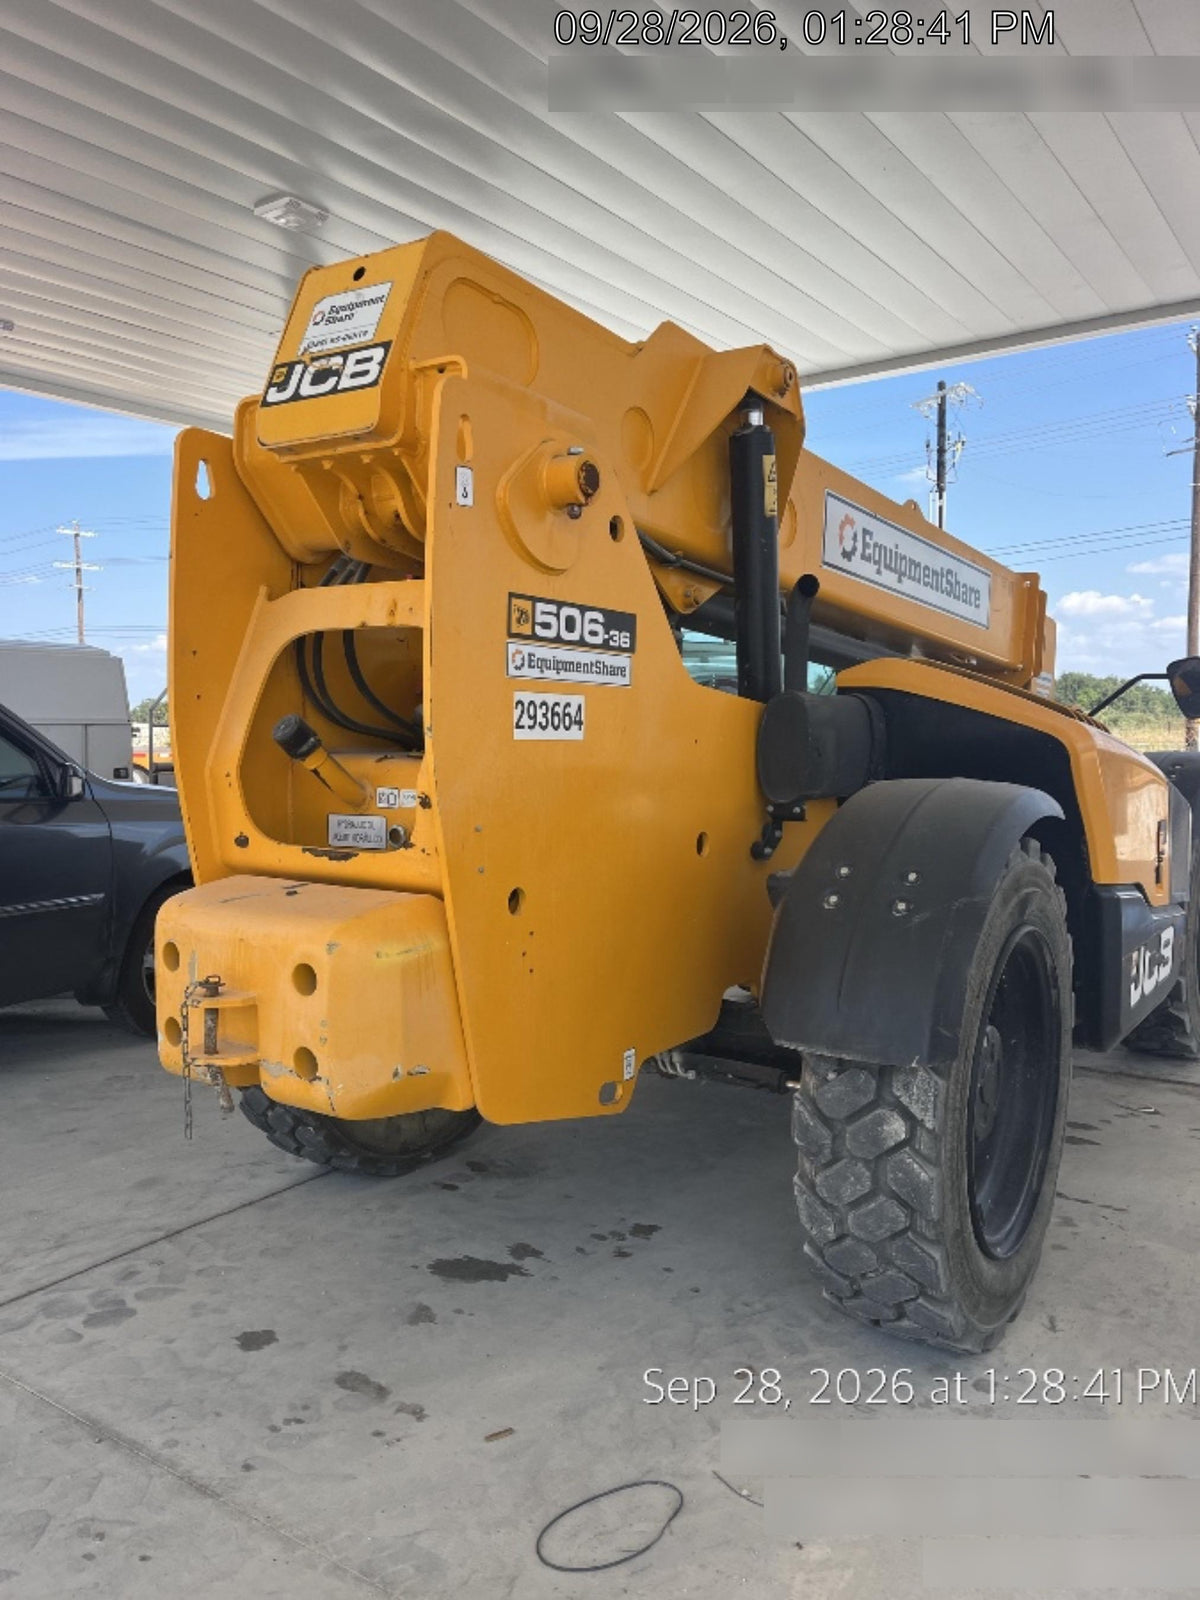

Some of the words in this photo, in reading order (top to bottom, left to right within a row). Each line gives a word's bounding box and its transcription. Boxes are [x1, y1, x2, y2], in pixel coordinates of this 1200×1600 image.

[265, 346, 386, 403] JCB
[859, 526, 982, 610] EquipmentShare
[527, 651, 627, 679] EquipmentShare
[514, 698, 584, 732] 293664
